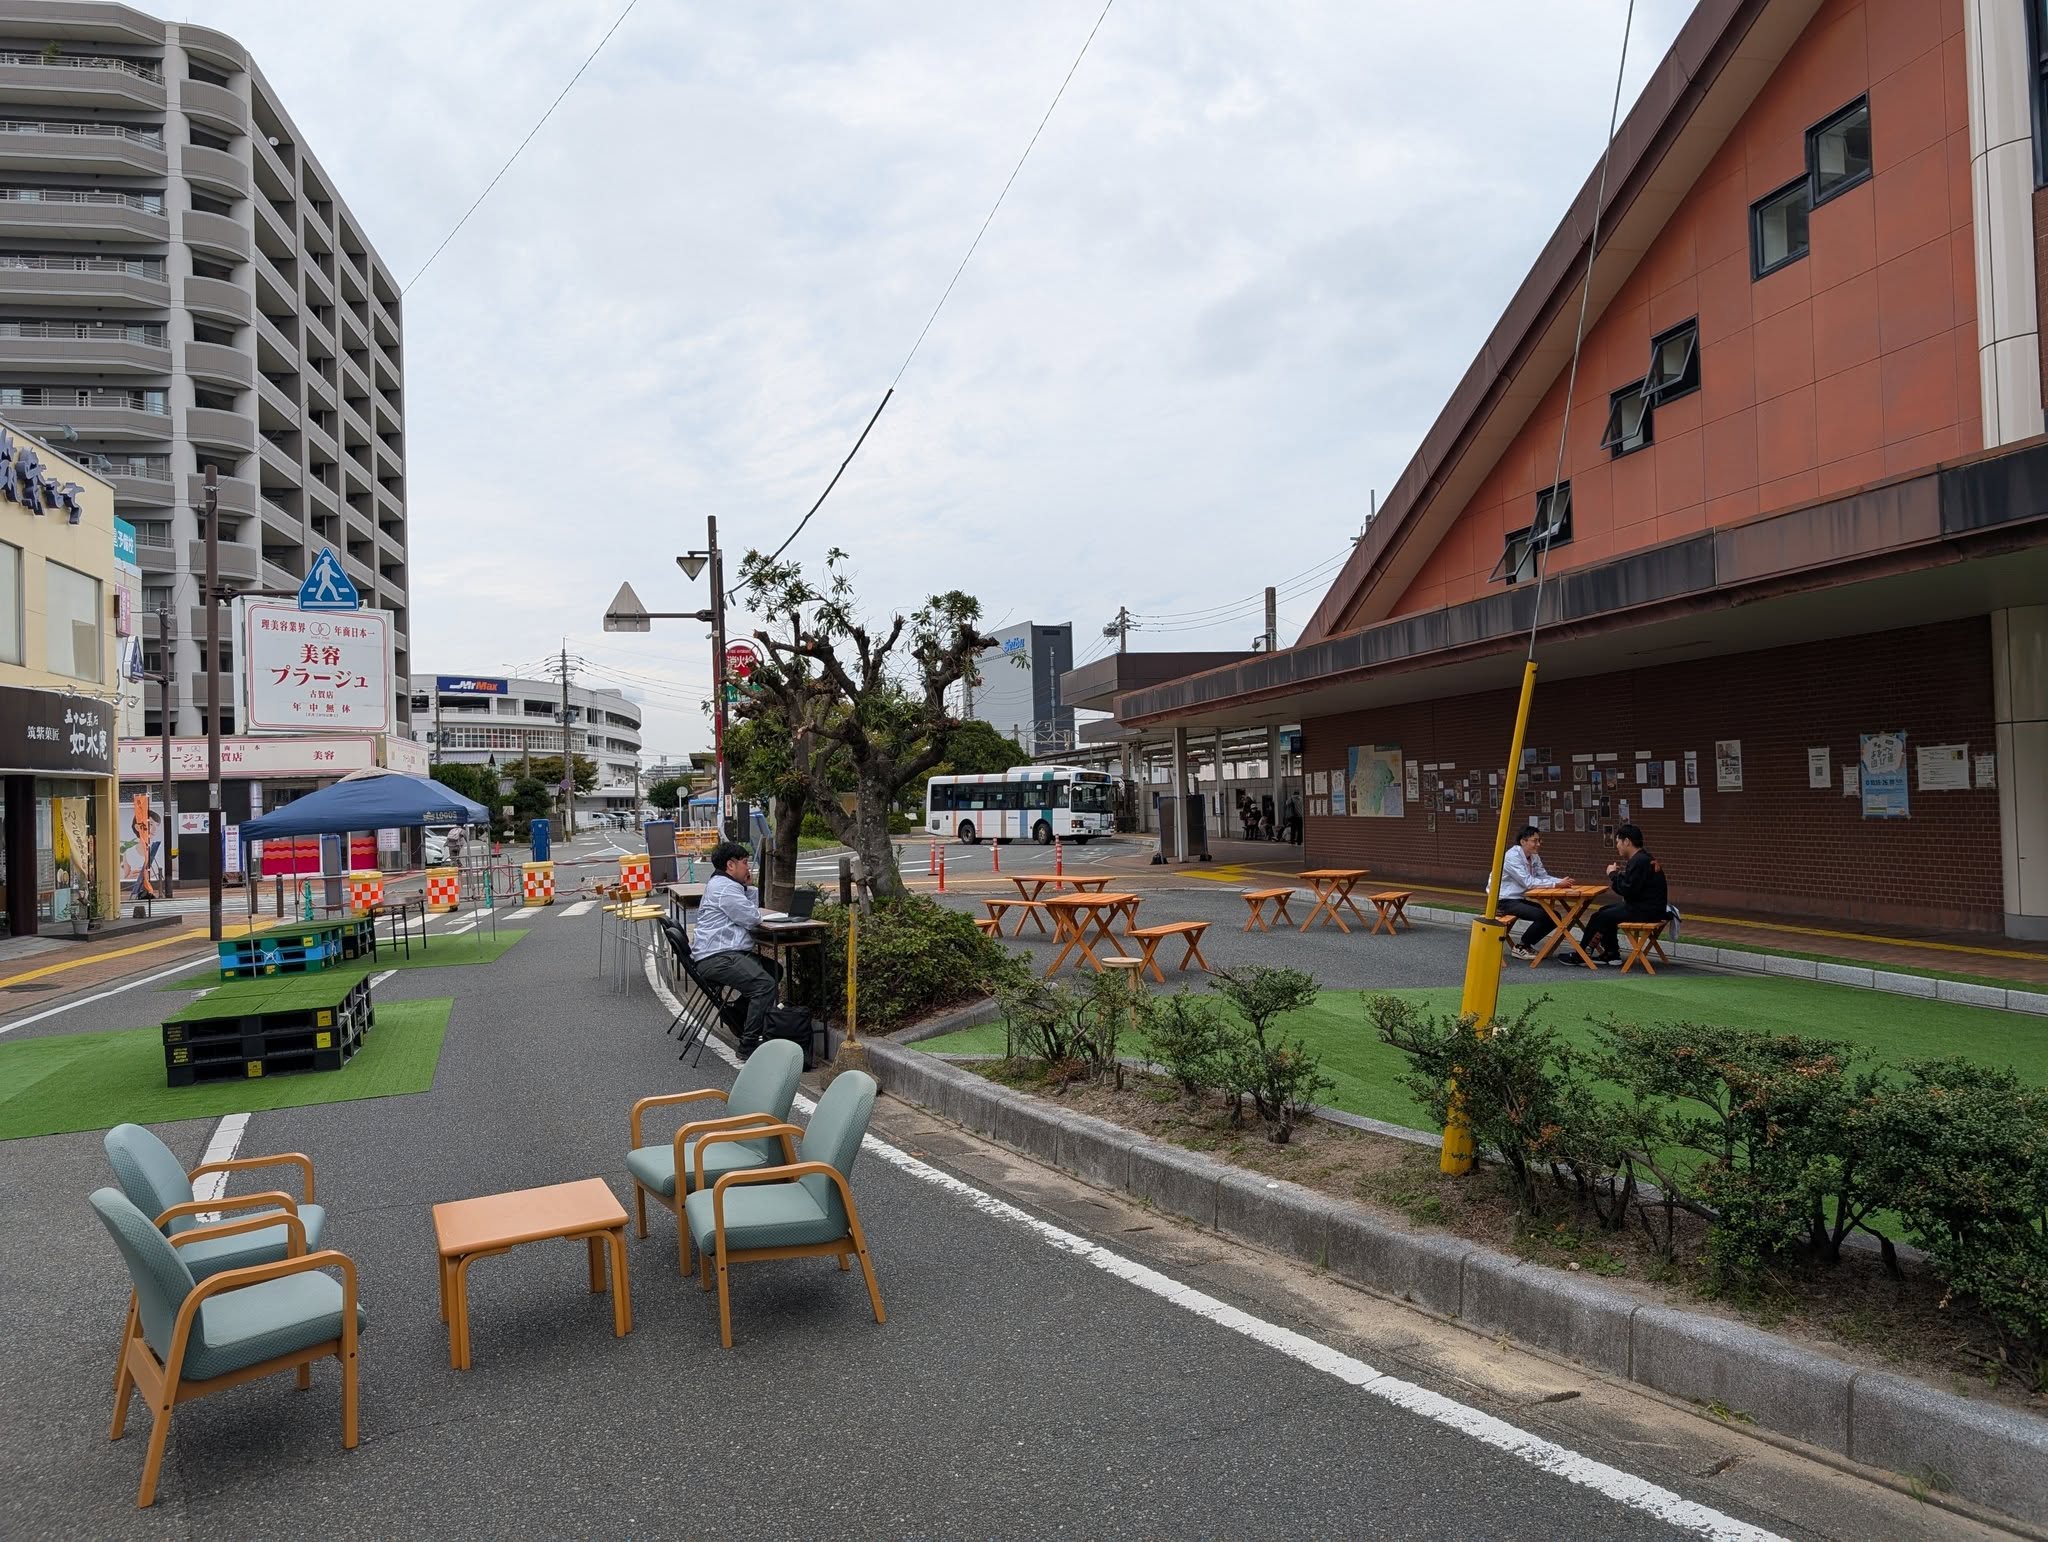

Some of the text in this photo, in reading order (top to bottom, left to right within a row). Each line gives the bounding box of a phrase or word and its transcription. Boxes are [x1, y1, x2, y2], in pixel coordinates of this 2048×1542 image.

[261, 619, 306, 633] 理美容業界
[334, 626, 376, 638] 年商日本一
[300, 643, 341, 666] 美容
[271, 665, 369, 688] プラージュ
[449, 680, 498, 691] MrMax
[310, 690, 334, 699] 古賀店
[292, 703, 351, 713] 年中無休
[27, 725, 60, 741] 筑紫菓匠
[70, 723, 108, 760] 如水庵
[149, 753, 203, 763] プージュ
[313, 750, 335, 761] 美容
[435, 811, 457, 820] LOGOS
